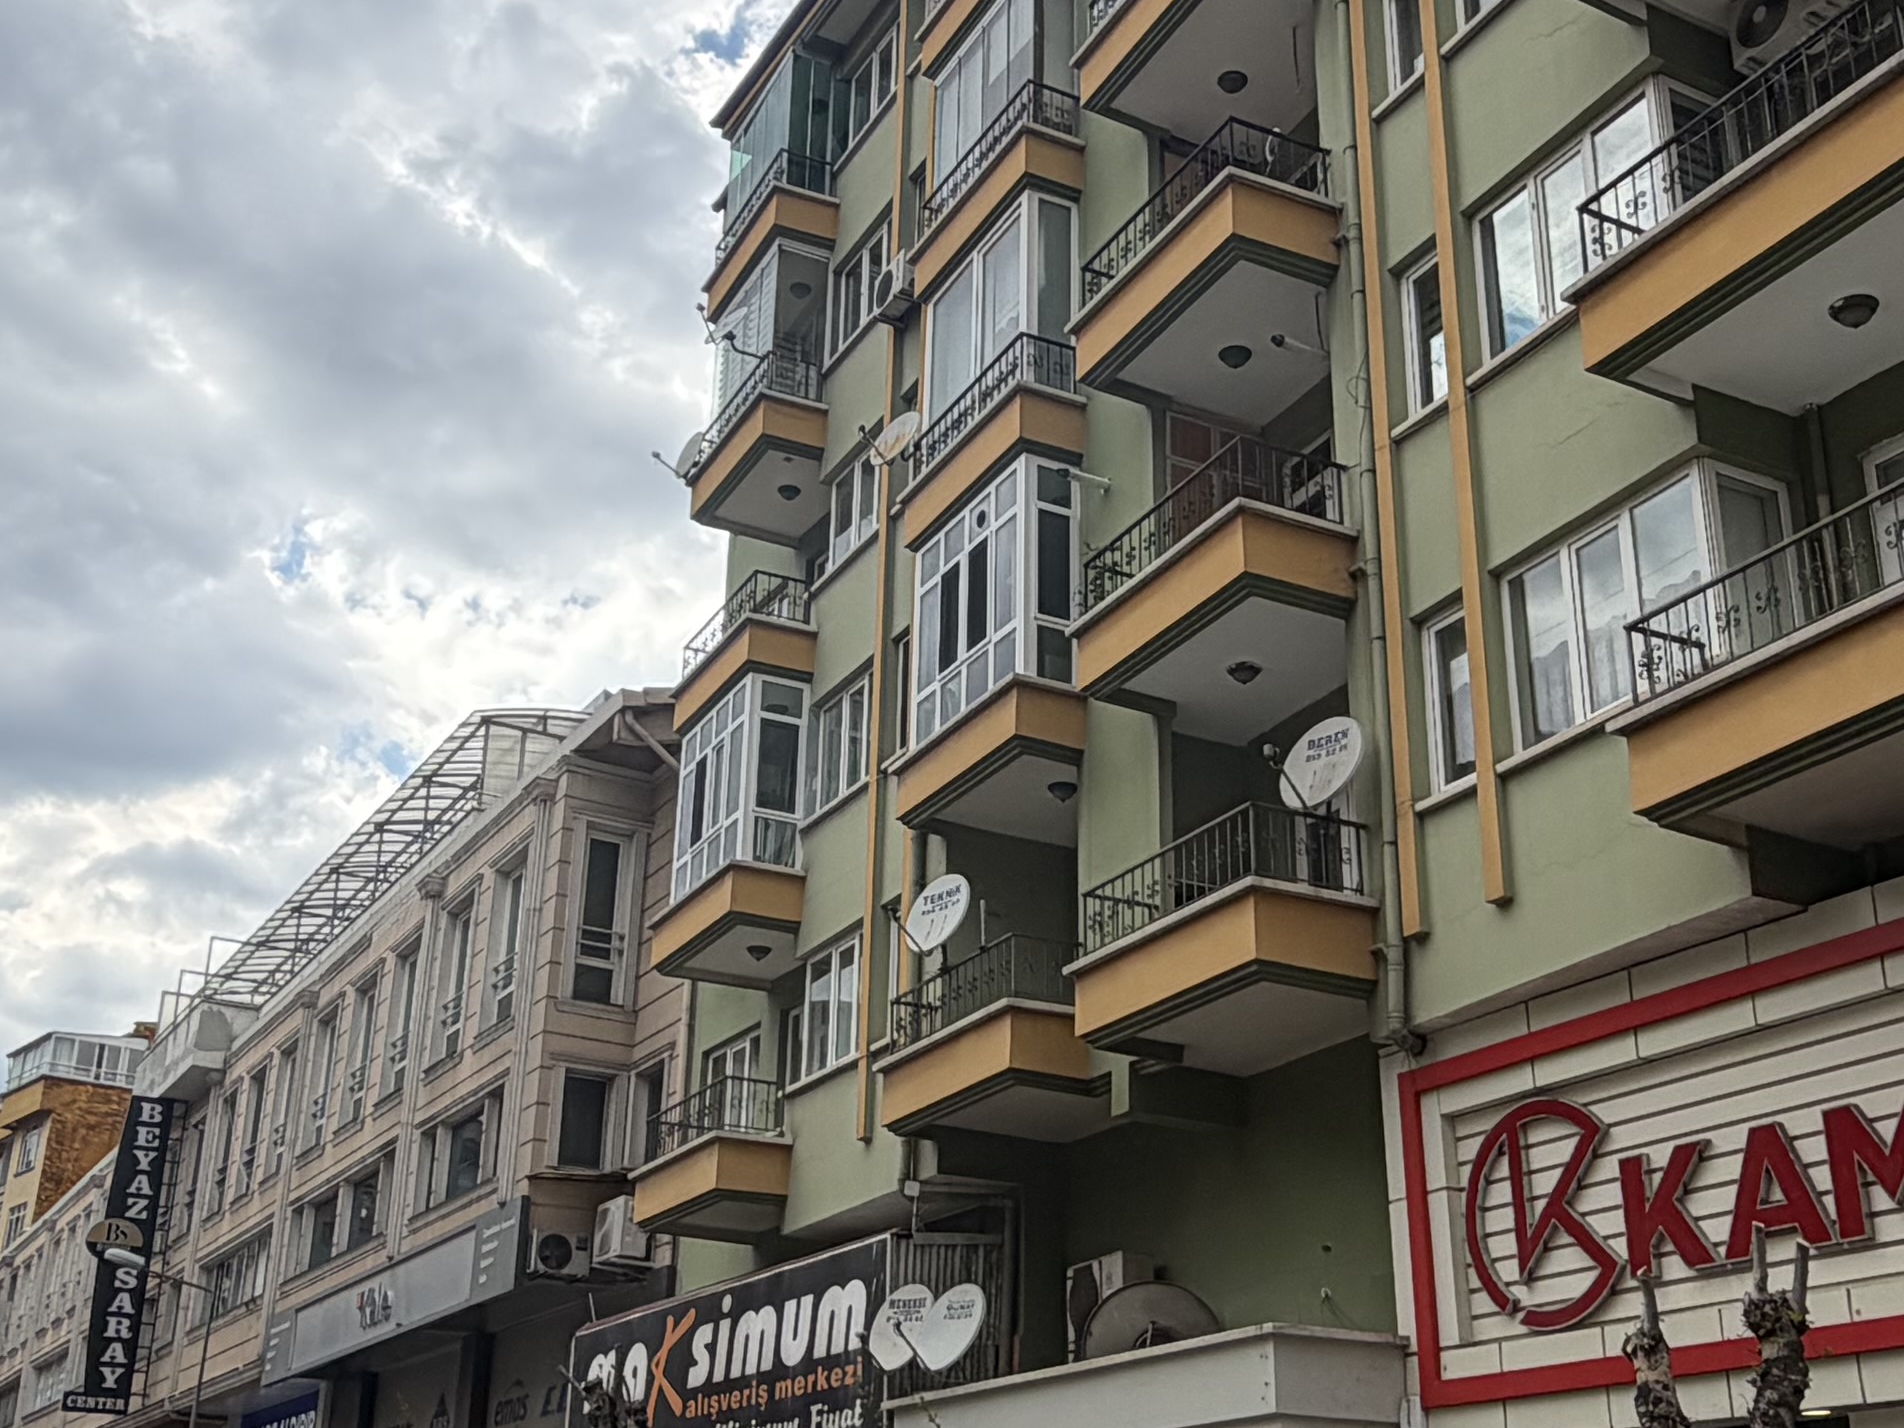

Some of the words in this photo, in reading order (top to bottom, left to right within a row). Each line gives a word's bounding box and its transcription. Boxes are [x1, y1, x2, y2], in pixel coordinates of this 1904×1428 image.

[123, 1100, 165, 1221] BEYAZ
[99, 1266, 138, 1390] SARAY
[65, 1393, 127, 1412] CENTER
[684, 1376, 769, 1421] alışveriş
[773, 1355, 865, 1401] merkezi
